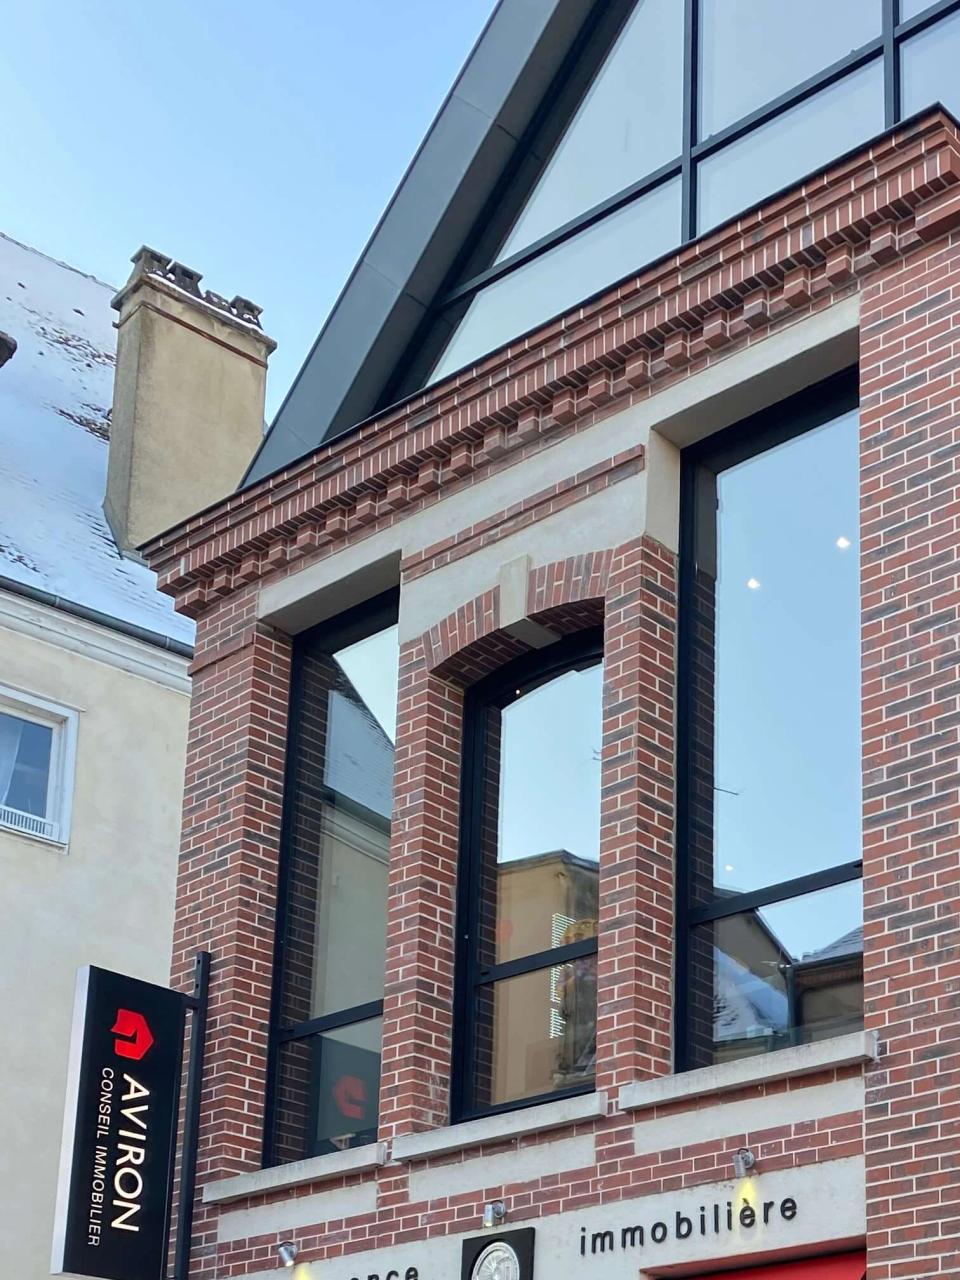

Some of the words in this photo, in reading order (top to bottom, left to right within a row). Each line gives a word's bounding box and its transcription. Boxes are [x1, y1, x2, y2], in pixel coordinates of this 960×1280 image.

[97, 1067, 114, 1139] CONSEIL
[87, 1145, 108, 1246] IMMOBILIER
[111, 1073, 150, 1232] AVIRON
[580, 1197, 798, 1256] immobilière
